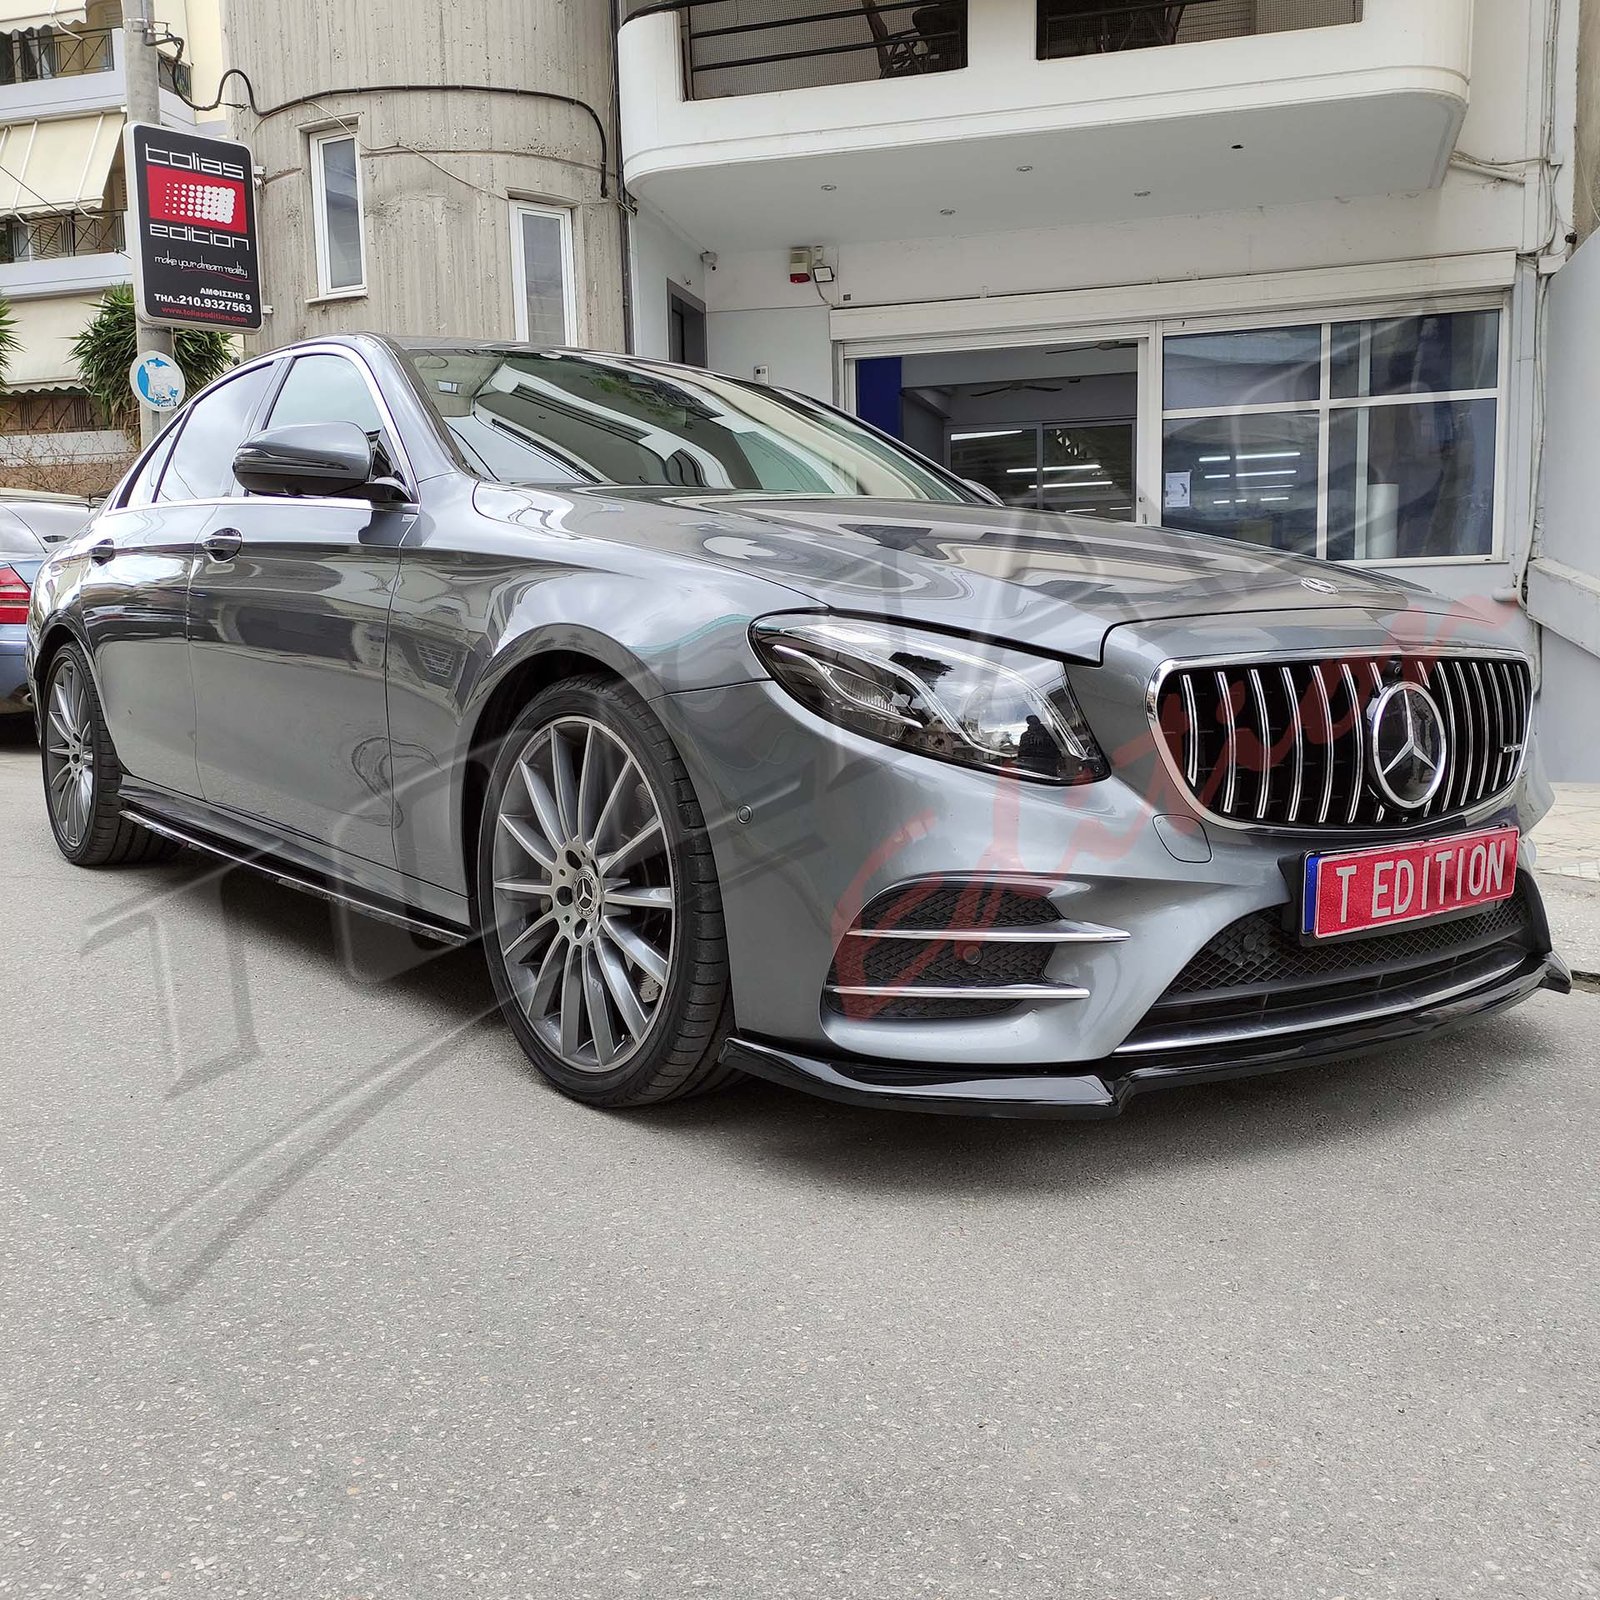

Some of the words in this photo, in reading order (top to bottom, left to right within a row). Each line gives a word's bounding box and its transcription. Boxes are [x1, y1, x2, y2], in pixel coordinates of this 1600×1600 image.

[145, 143, 244, 180] tolias
[149, 223, 249, 251] edition
[155, 250, 177, 266] make
[178, 259, 197, 270] your
[197, 255, 224, 273] dream
[224, 261, 248, 279] reality
[200, 287, 243, 300] ΑΜΦΙΣΣΗΣ
[245, 293, 251, 301] 9
[161, 307, 248, 323] www.toliasedition.com
[1336, 865, 1357, 923] T
[1371, 840, 1506, 918] EDITION
